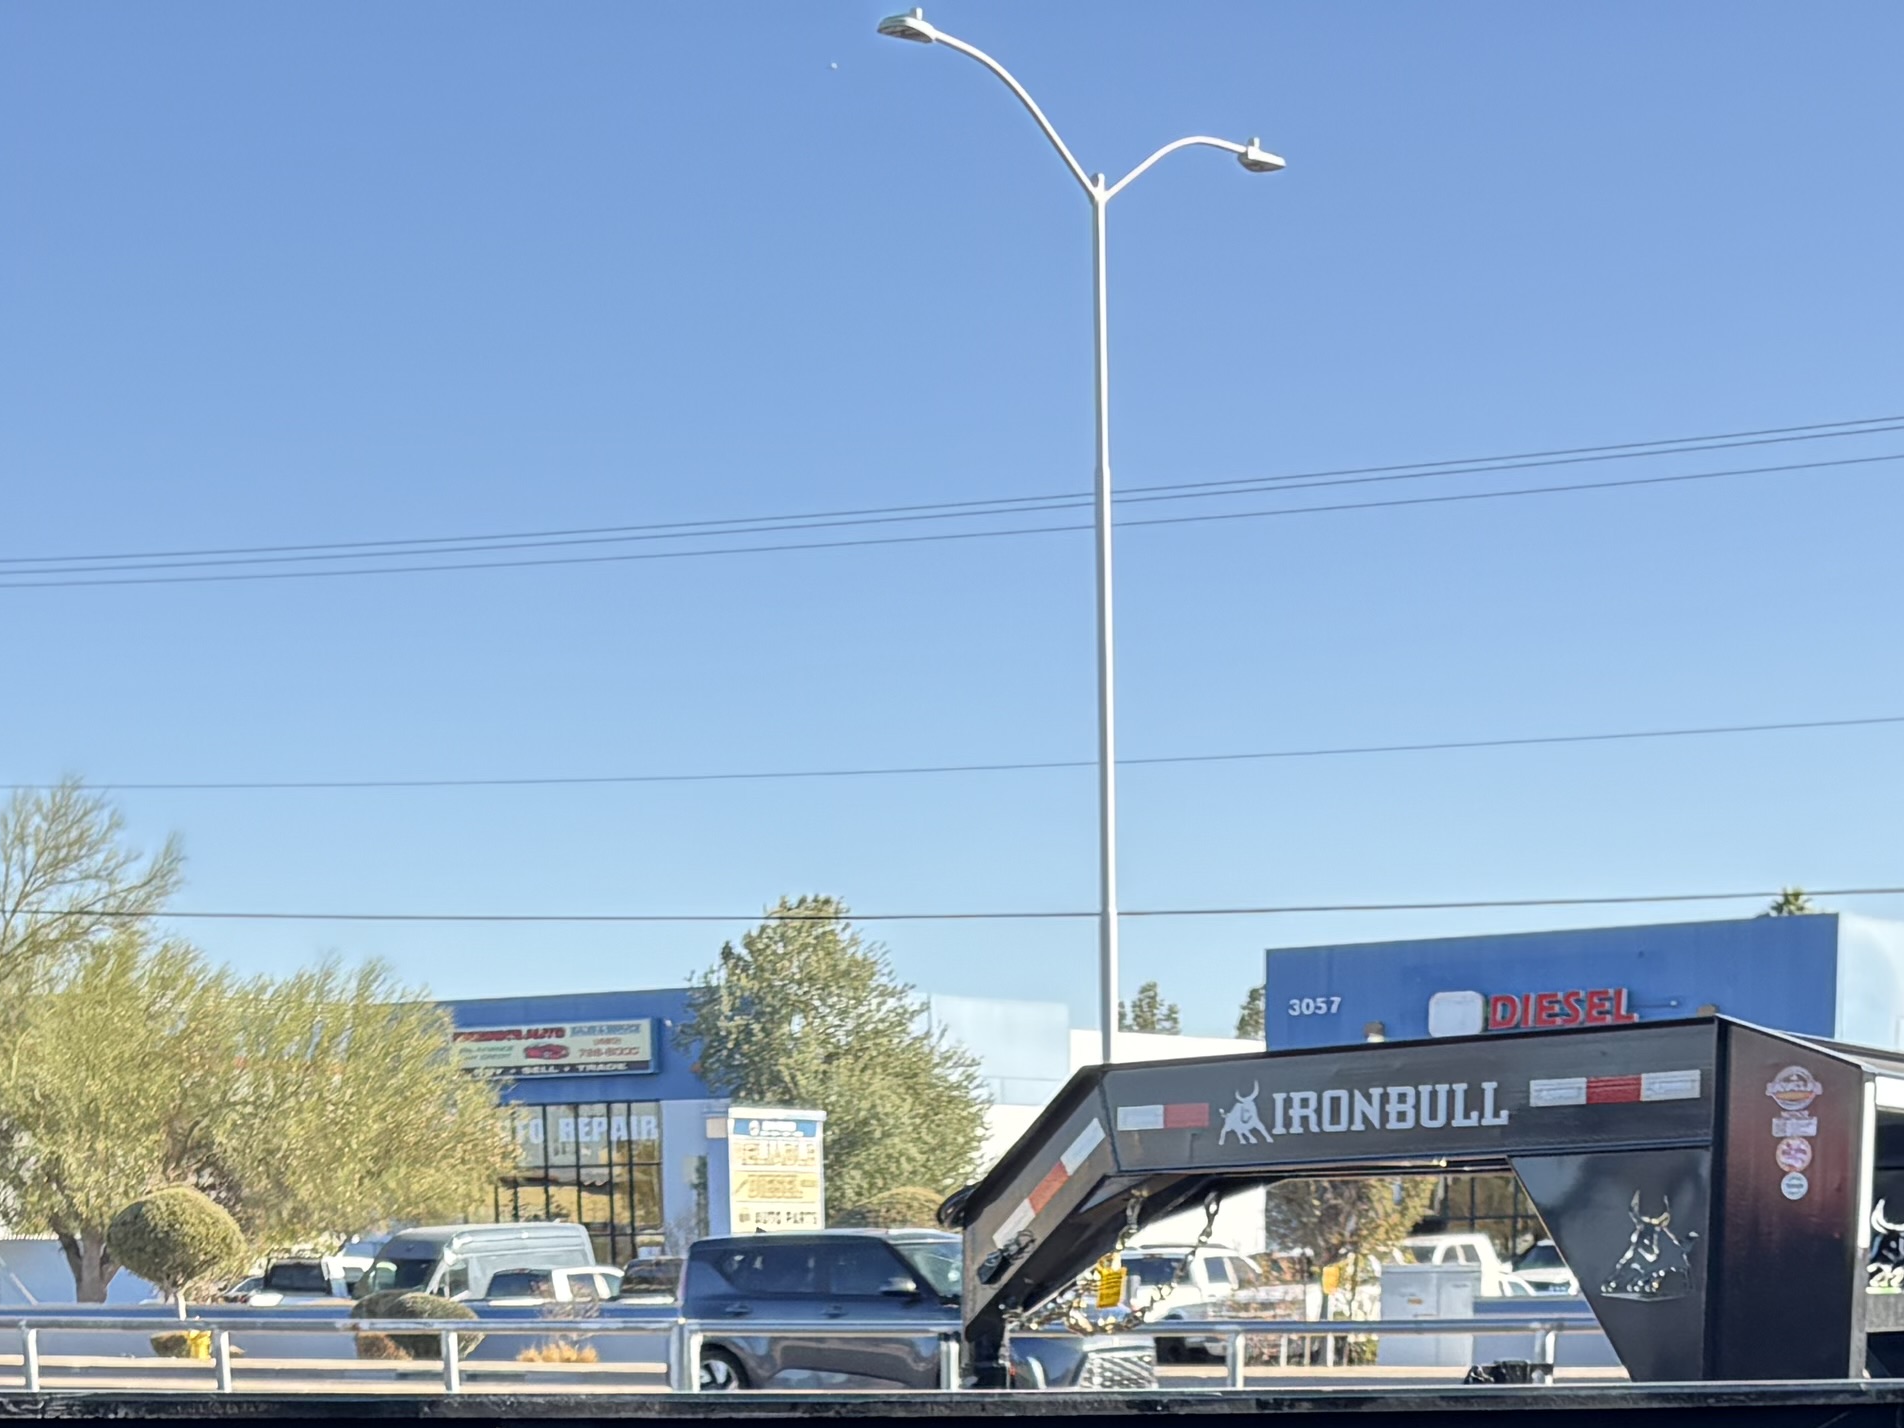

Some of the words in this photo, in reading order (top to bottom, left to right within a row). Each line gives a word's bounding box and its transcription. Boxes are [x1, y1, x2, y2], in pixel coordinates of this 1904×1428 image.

[1288, 997, 1341, 1016] 3057
[1488, 988, 1638, 1030] DIESEL
[558, 1114, 659, 1142] REPAIR
[1272, 1081, 1509, 1134] IRONBULL
